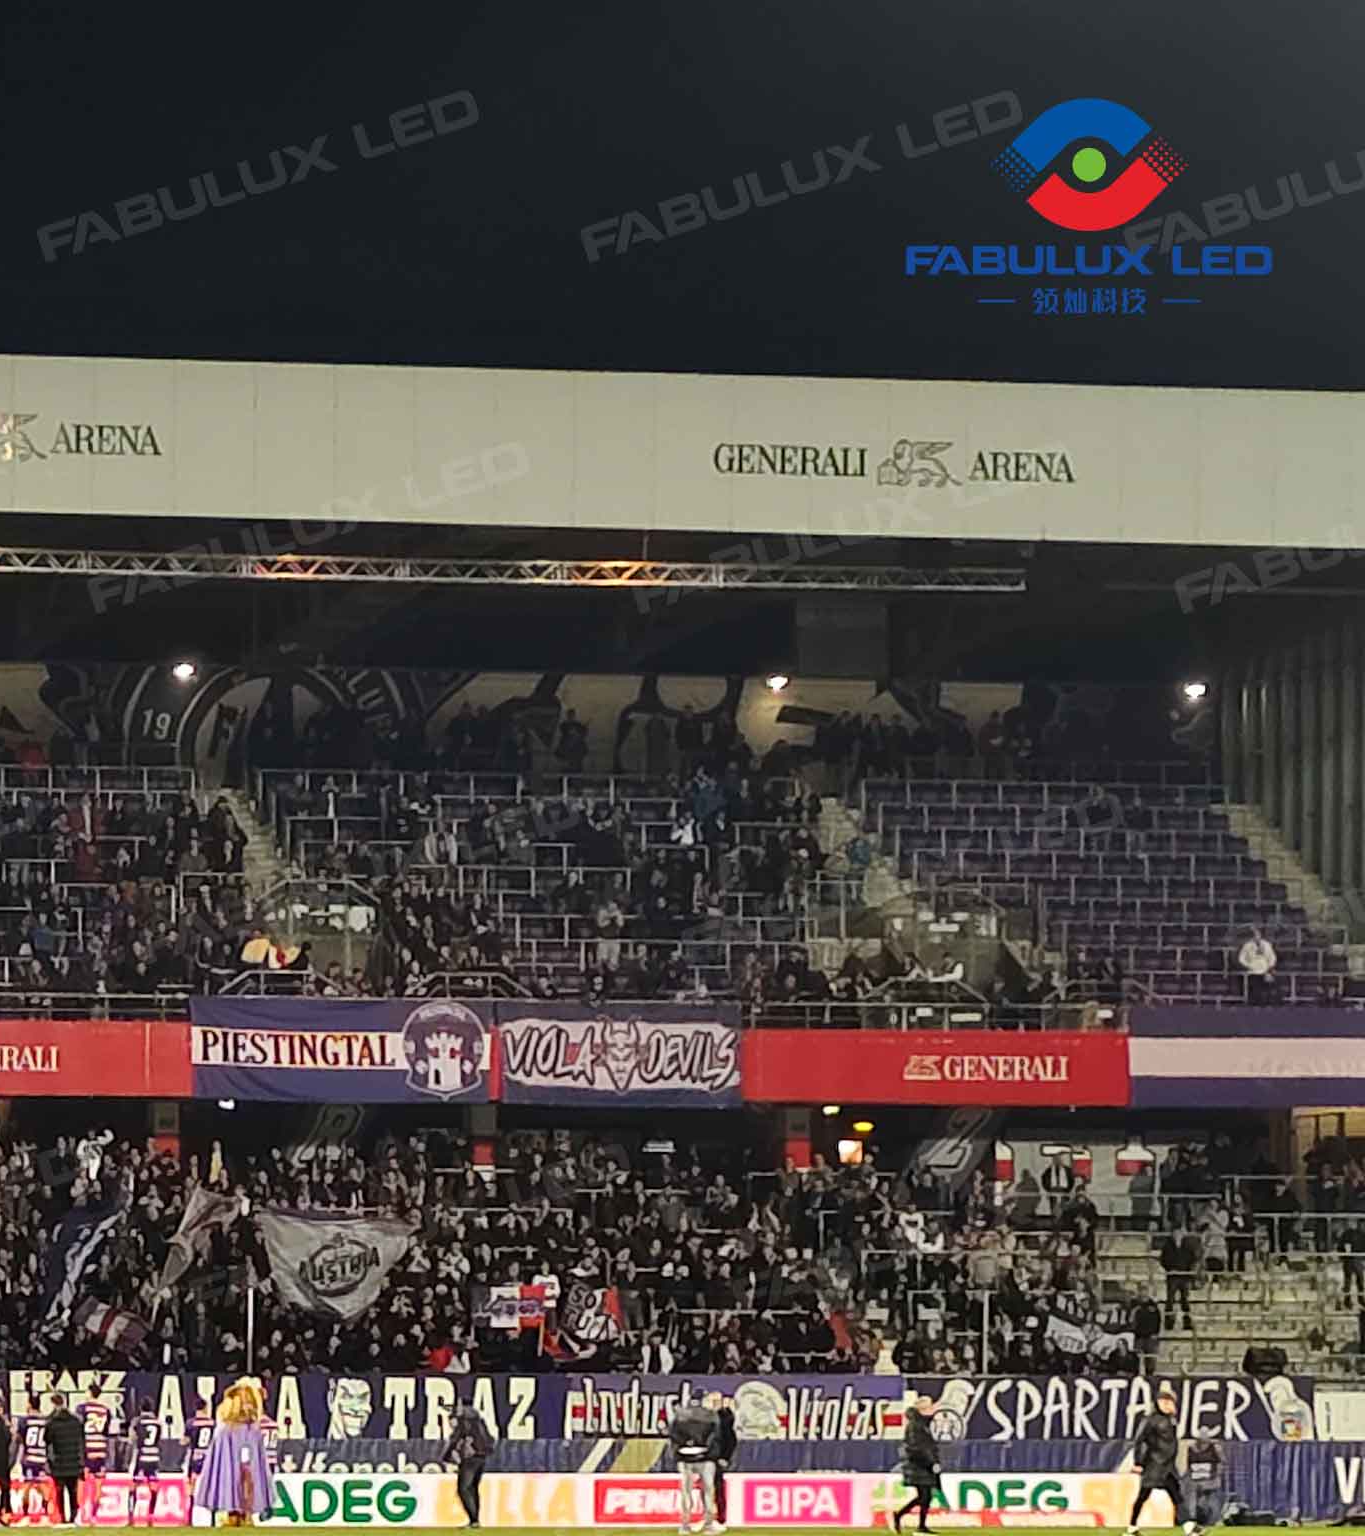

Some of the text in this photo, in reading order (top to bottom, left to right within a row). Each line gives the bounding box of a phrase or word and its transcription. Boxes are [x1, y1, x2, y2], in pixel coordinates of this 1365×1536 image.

[51, 423, 161, 458] ARENA
[714, 443, 1075, 484] GENERALI ARENA
[200, 1027, 396, 1068] PIESTINGTAL
[506, 1024, 737, 1091] VIOLA DEVILS
[943, 1054, 1069, 1081] GENERALI
[272, 1479, 418, 1523] ADEG
[755, 1487, 841, 1518] BIPA
